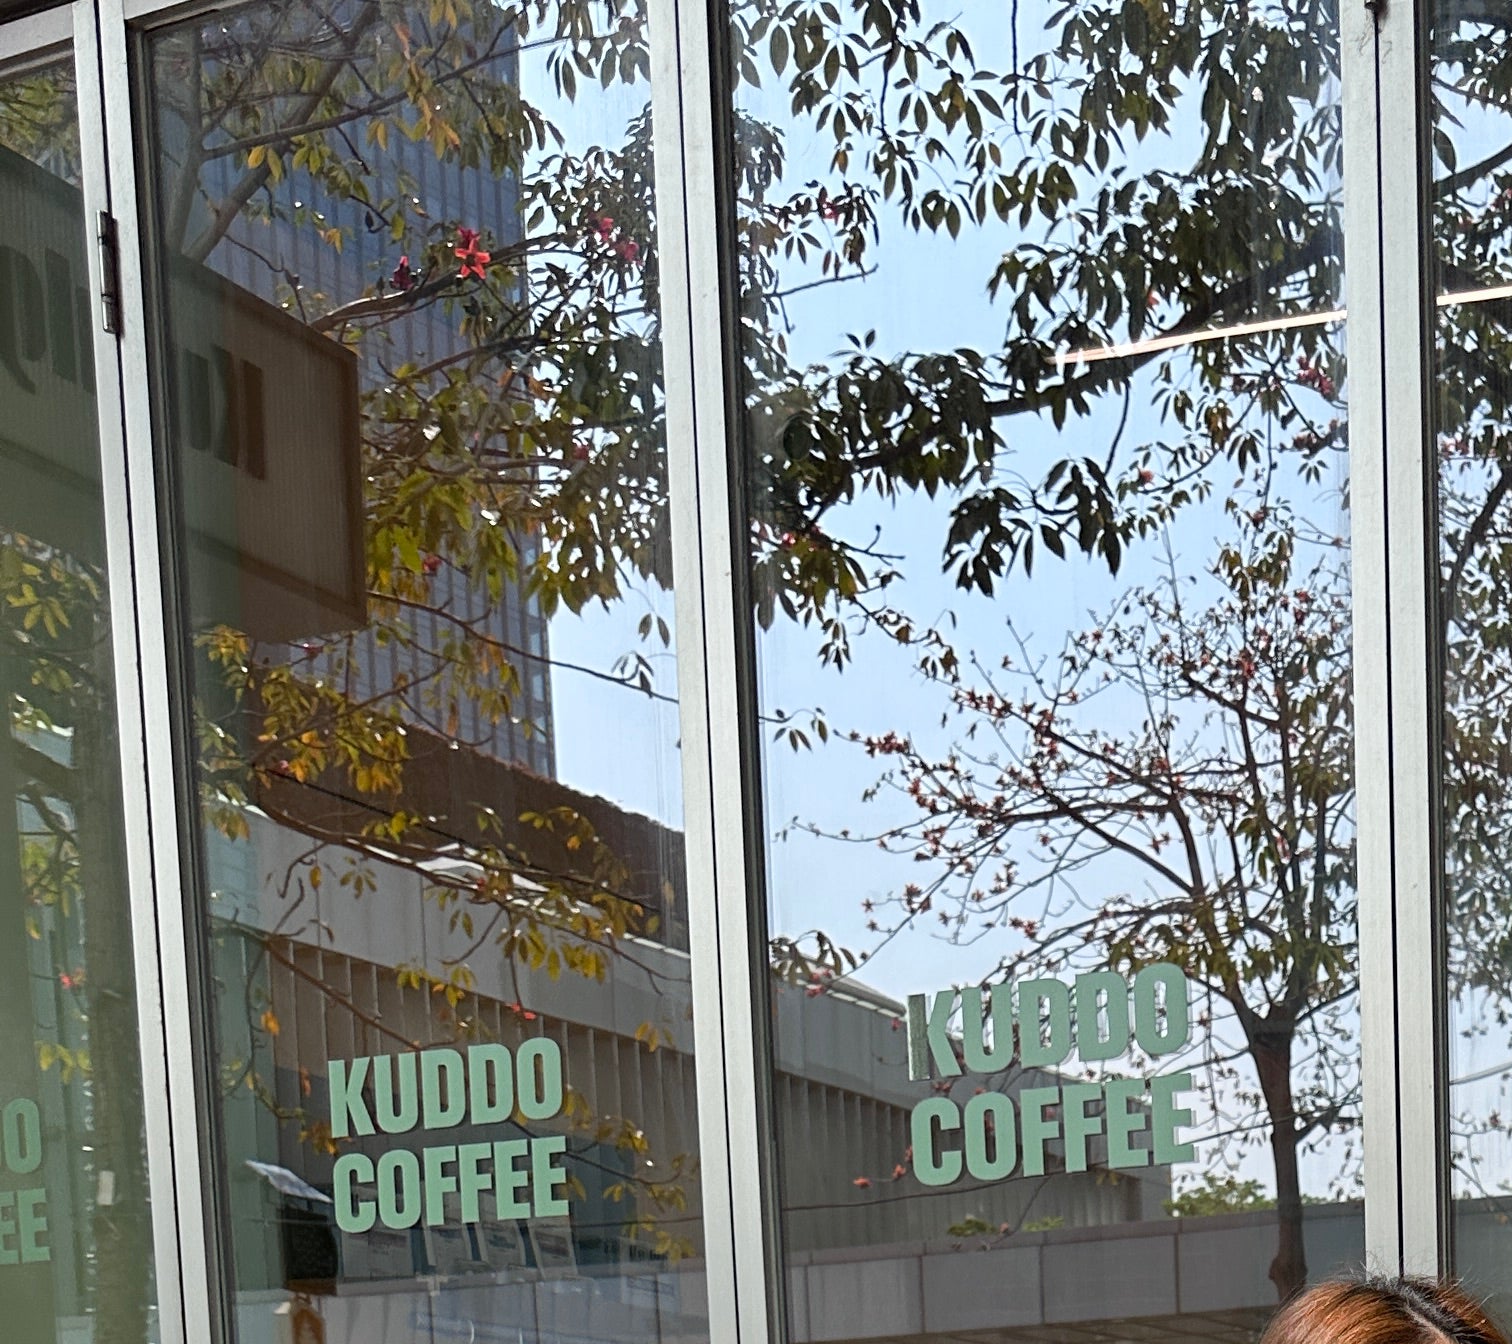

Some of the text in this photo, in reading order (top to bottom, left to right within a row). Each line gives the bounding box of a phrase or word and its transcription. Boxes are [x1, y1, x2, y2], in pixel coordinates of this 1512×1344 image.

[907, 962, 1190, 1081] KUDDO
[328, 1037, 564, 1138] KUDDO
[911, 1073, 1197, 1187] COFFEE
[332, 1136, 570, 1233] COFFEE
